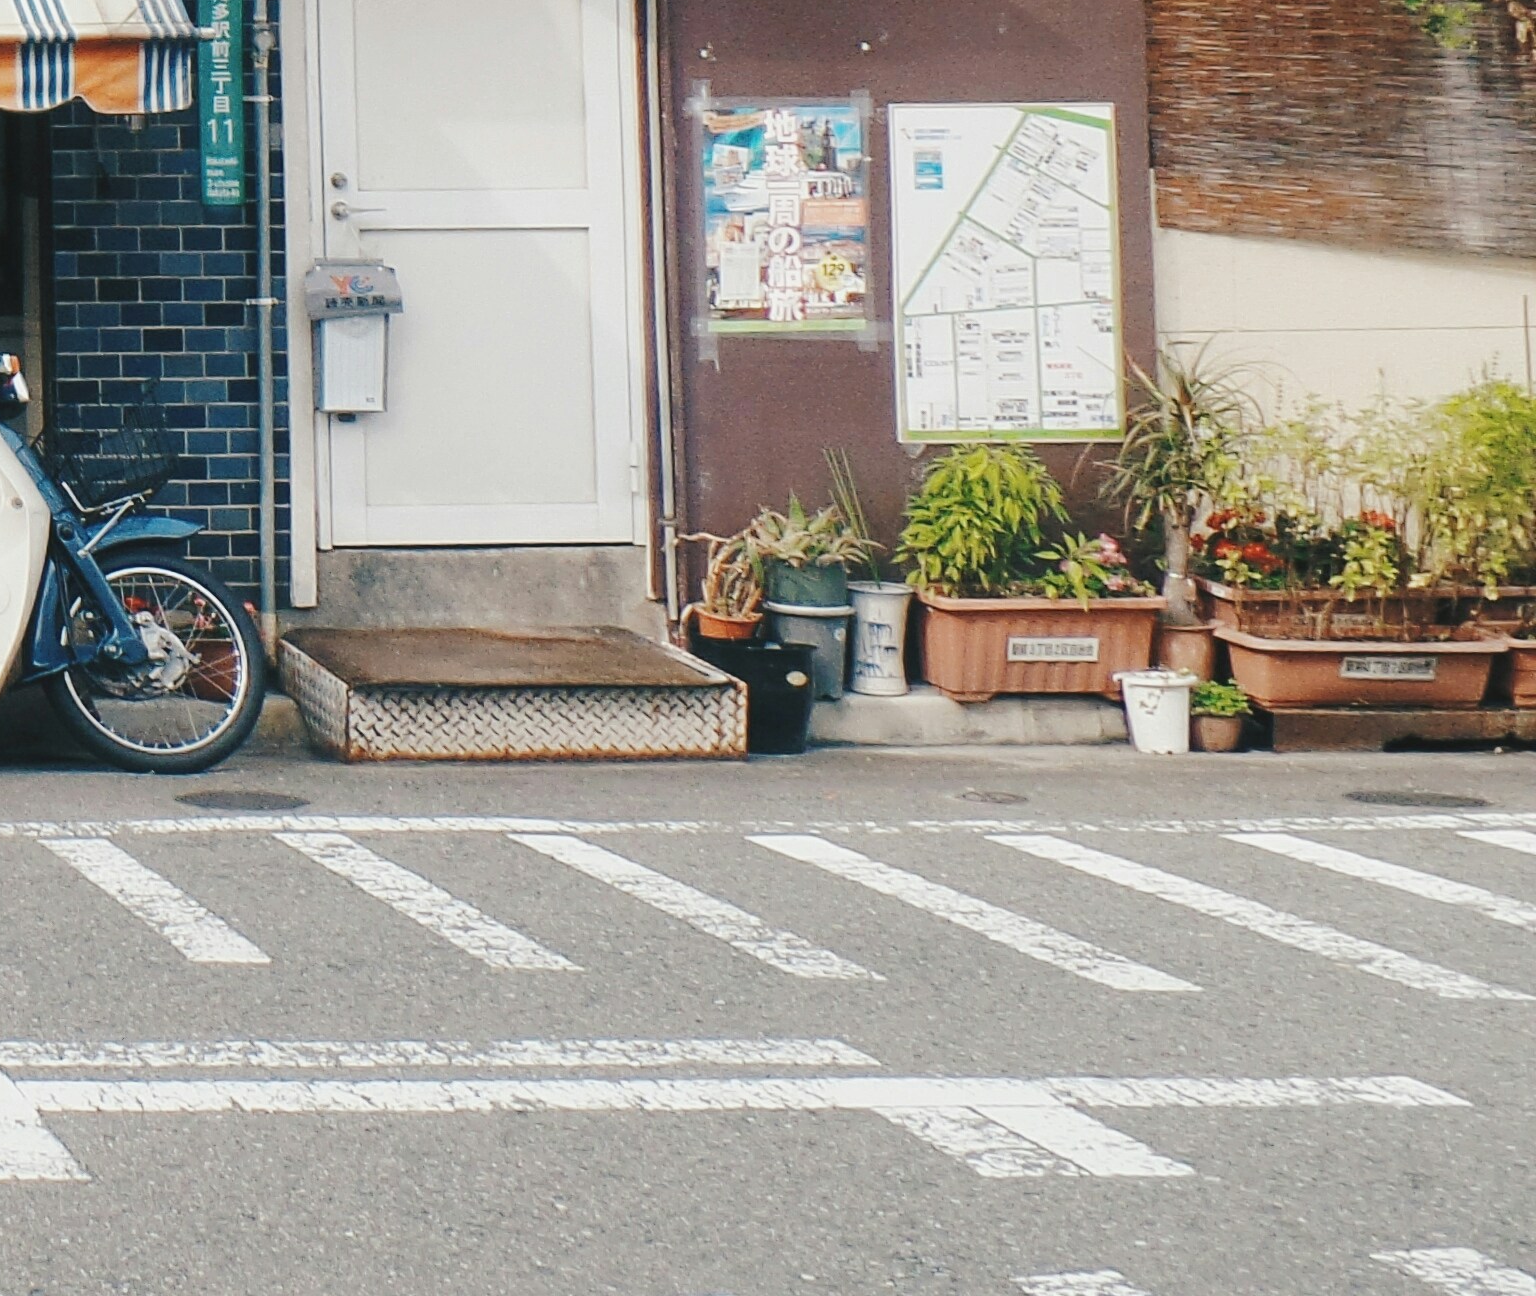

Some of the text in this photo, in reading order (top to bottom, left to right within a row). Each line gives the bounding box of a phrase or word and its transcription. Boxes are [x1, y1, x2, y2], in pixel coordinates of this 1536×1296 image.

[206, 118, 234, 144] 11
[764, 109, 804, 322] 地球一周の船旅
